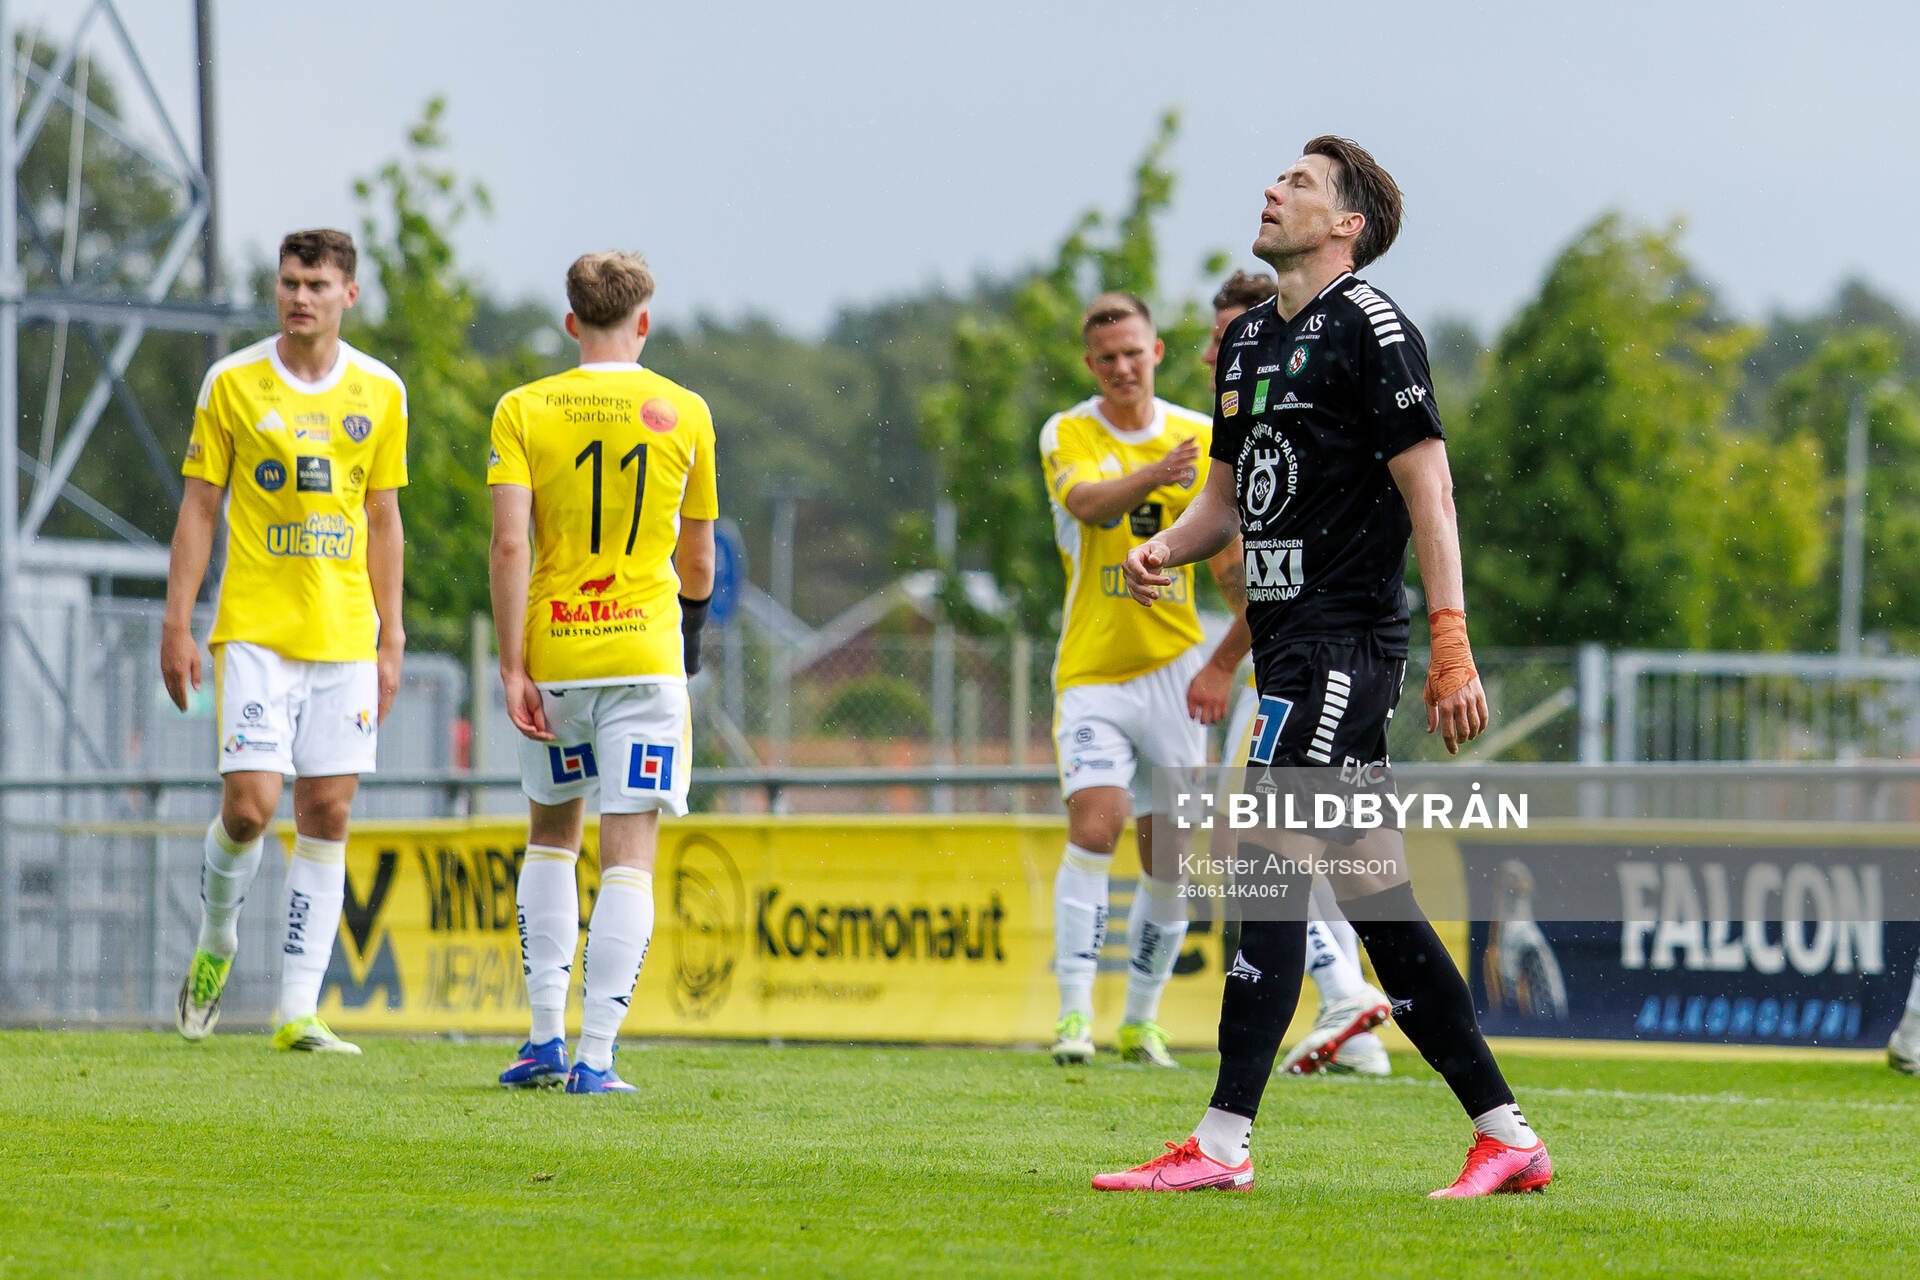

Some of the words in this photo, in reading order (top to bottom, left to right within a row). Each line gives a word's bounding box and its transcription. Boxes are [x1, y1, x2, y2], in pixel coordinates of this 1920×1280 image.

[546, 394, 632, 410] Falkenbergs
[564, 410, 631, 424] Sparbank
[1274, 431, 1283, 443] &
[1280, 439, 1298, 495] PASSION
[575, 440, 648, 556] 11
[266, 522, 355, 560] Ullared
[1245, 549, 1305, 587] AXI
[551, 624, 647, 637] SURSTRÖMMING
[756, 886, 1006, 963] Kosmonaut
[1616, 861, 1886, 975] FALCON
